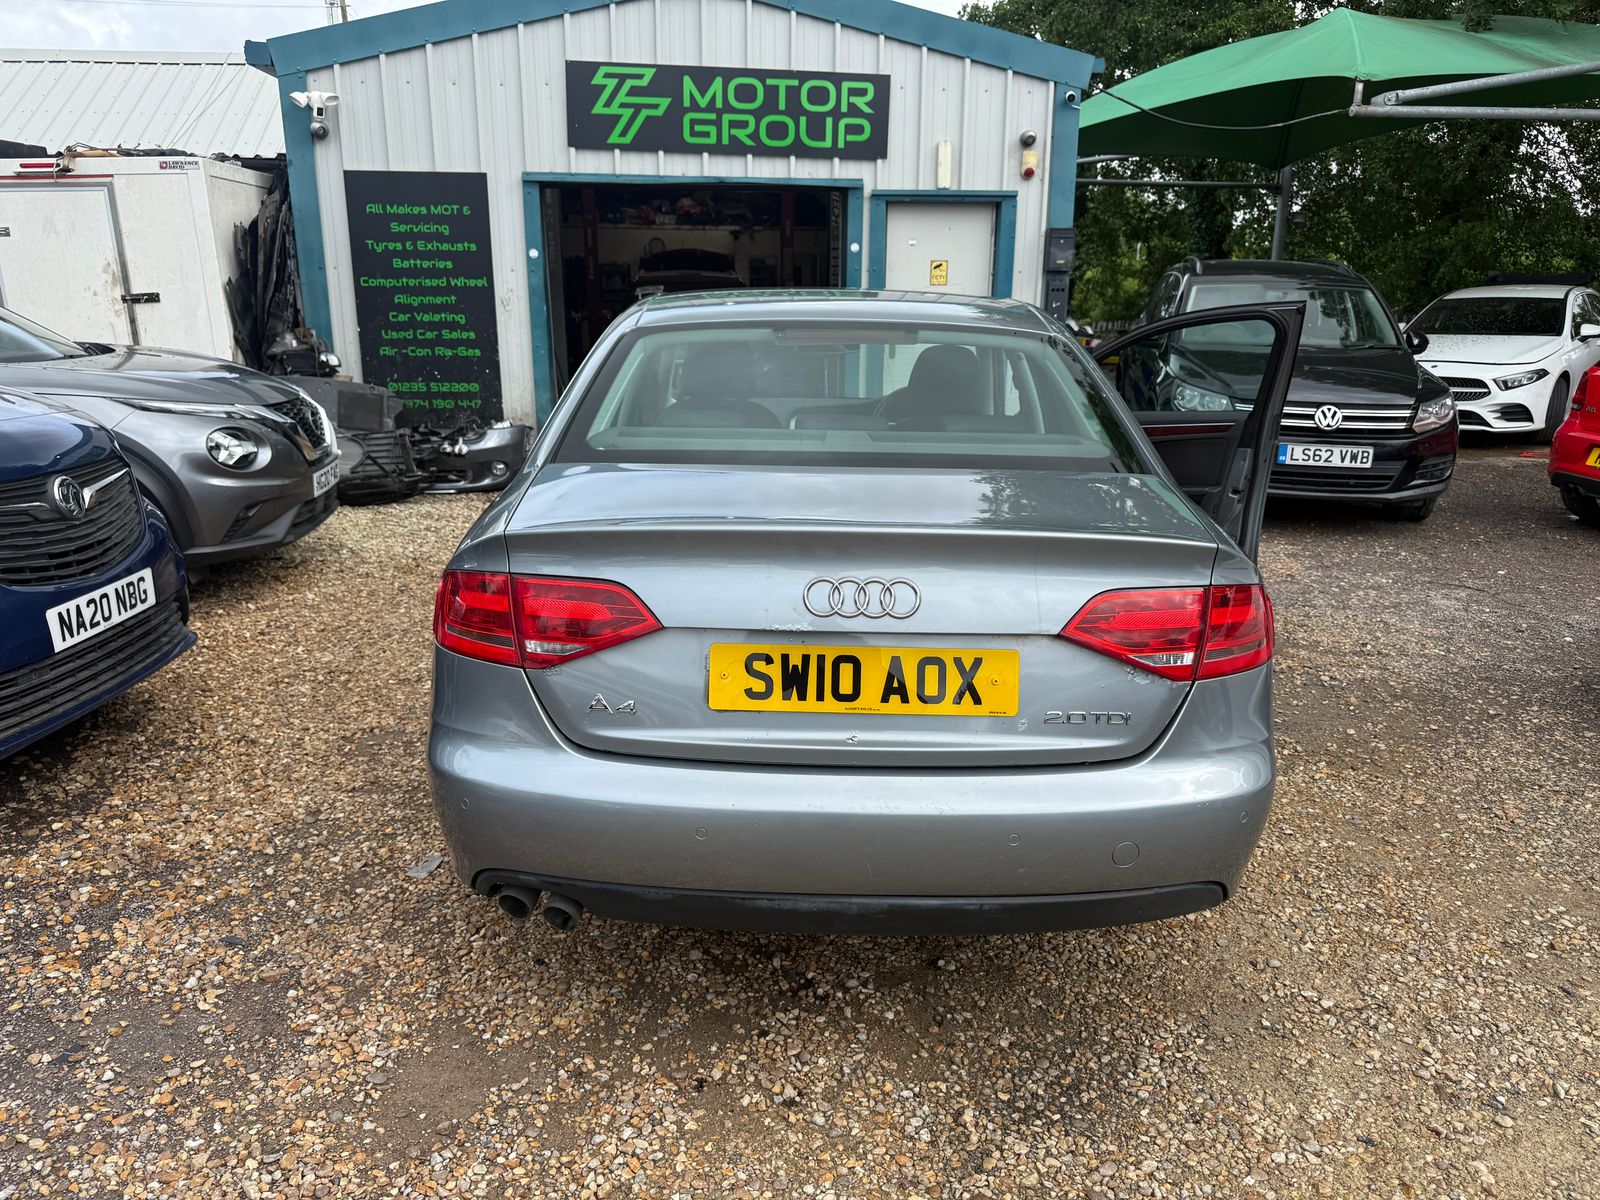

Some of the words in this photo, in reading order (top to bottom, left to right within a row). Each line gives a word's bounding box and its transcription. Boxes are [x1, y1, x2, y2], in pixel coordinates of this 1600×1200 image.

[682, 75, 875, 114] MOTOR
[682, 112, 872, 149] GROUP
[366, 203, 383, 214] All
[386, 204, 427, 215] Makes
[430, 205, 459, 215] MOT
[463, 207, 471, 215] &
[390, 222, 450, 236] Servicing
[365, 240, 402, 252] Tyres
[405, 241, 414, 250] &
[417, 241, 477, 251] Exhausts
[392, 258, 453, 269] Batteries
[360, 276, 447, 288] Computerised
[449, 276, 488, 287] Wheel
[394, 294, 457, 307] Alignment
[389, 312, 411, 322] Car
[414, 312, 466, 324] Valeting
[381, 329, 414, 340] Used
[416, 330, 438, 339] Car
[441, 329, 476, 340] Sales
[379, 347, 398, 356] Air
[435, 347, 481, 356] Re-Gas
[388, 382, 427, 392] 01235
[430, 382, 480, 392] 512200
[401, 399, 429, 409] 974
[432, 399, 455, 409] 190
[458, 399, 481, 409] 447
[1289, 446, 1334, 463] LS62
[1339, 449, 1370, 465] VWB
[57, 592, 112, 643] NA20
[114, 576, 148, 616] NBG
[744, 652, 862, 703] SW10
[880, 655, 984, 706] AOX
[589, 693, 637, 714] A4
[1044, 710, 1087, 725] 2.0
[1090, 711, 1131, 725] TDI
